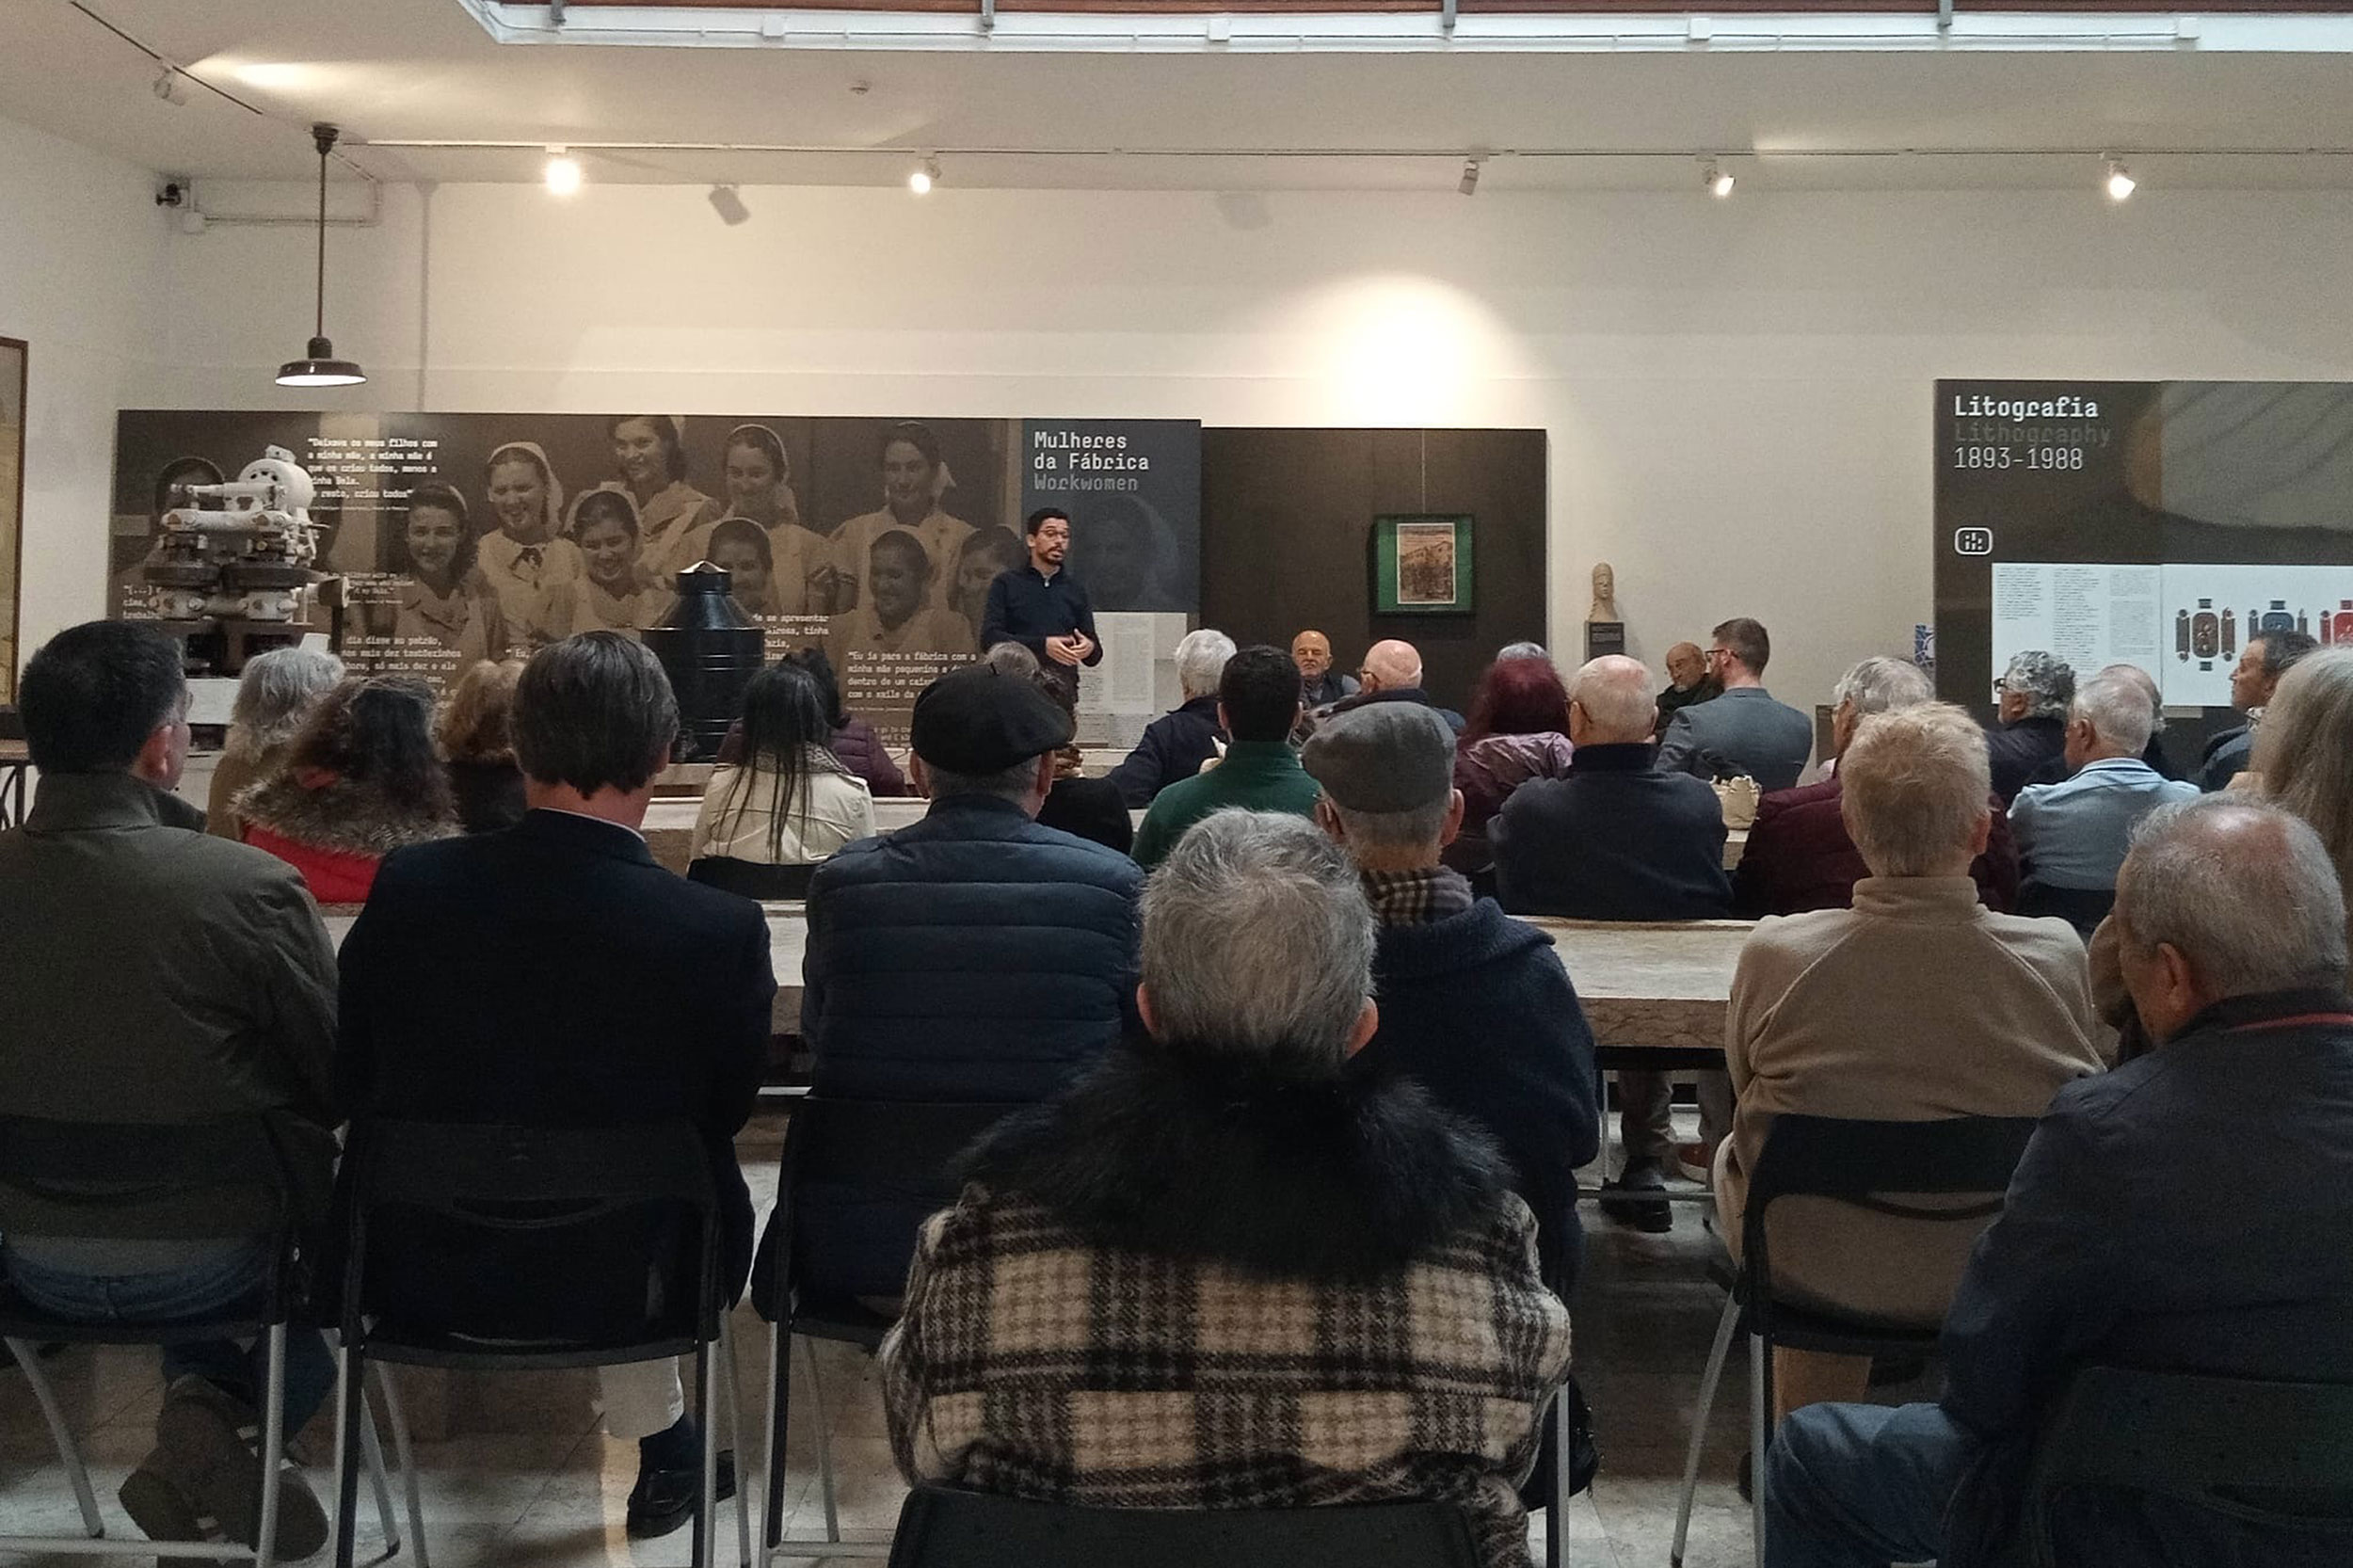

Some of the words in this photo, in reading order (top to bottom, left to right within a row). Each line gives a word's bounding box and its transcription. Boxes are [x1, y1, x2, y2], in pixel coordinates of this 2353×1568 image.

[1955, 395, 2099, 422] Litografia
[1034, 431, 1128, 449] Mulheres
[1955, 424, 2111, 447] Lithography
[1034, 453, 1056, 470] da
[1069, 453, 1149, 470] Fábrica
[1954, 447, 2083, 470] 1893-1988
[1034, 473, 1138, 490] Workwomen
